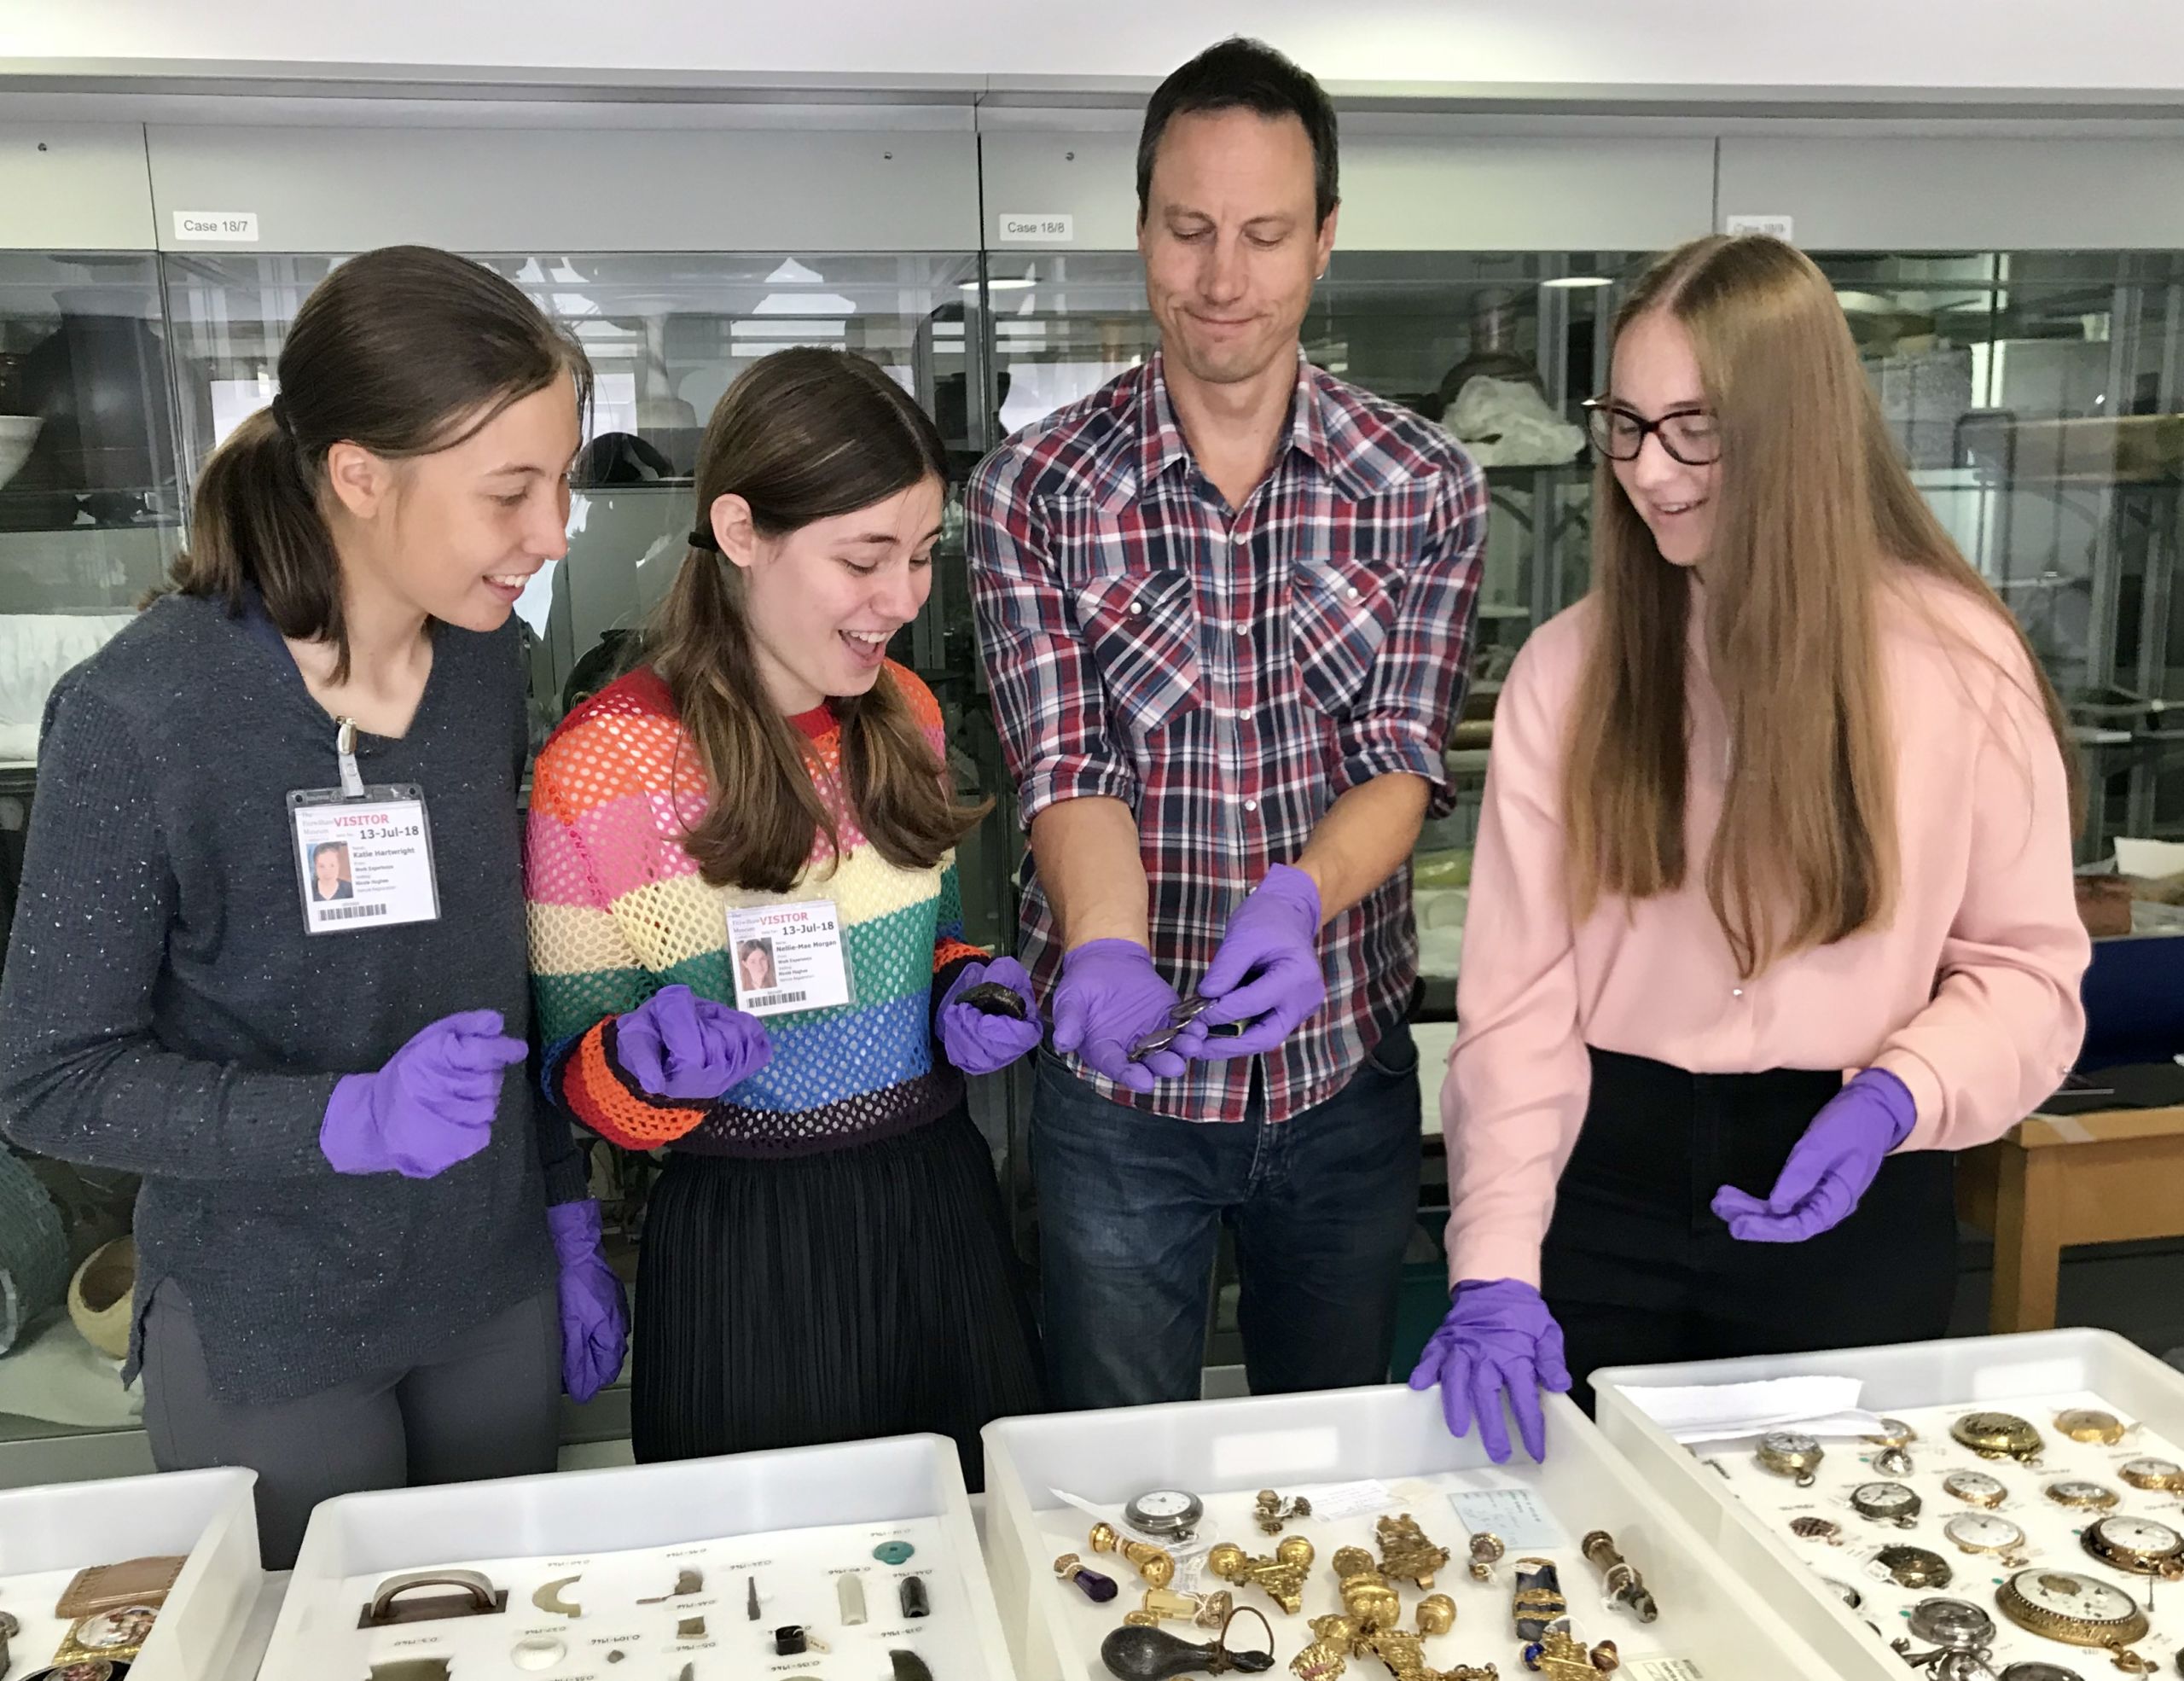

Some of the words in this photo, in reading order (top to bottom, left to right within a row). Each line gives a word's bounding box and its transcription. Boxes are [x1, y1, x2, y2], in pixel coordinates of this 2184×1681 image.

[183, 219, 218, 232] Case
[222, 220, 248, 232] 18/7
[1008, 222, 1037, 233] Case
[1041, 222, 1065, 233] 18/8
[334, 813, 390, 827] VISITOR
[360, 825, 419, 840] 13-Jul-18
[760, 912, 809, 926] VISITOR
[782, 921, 835, 936] 13-Jul-18
